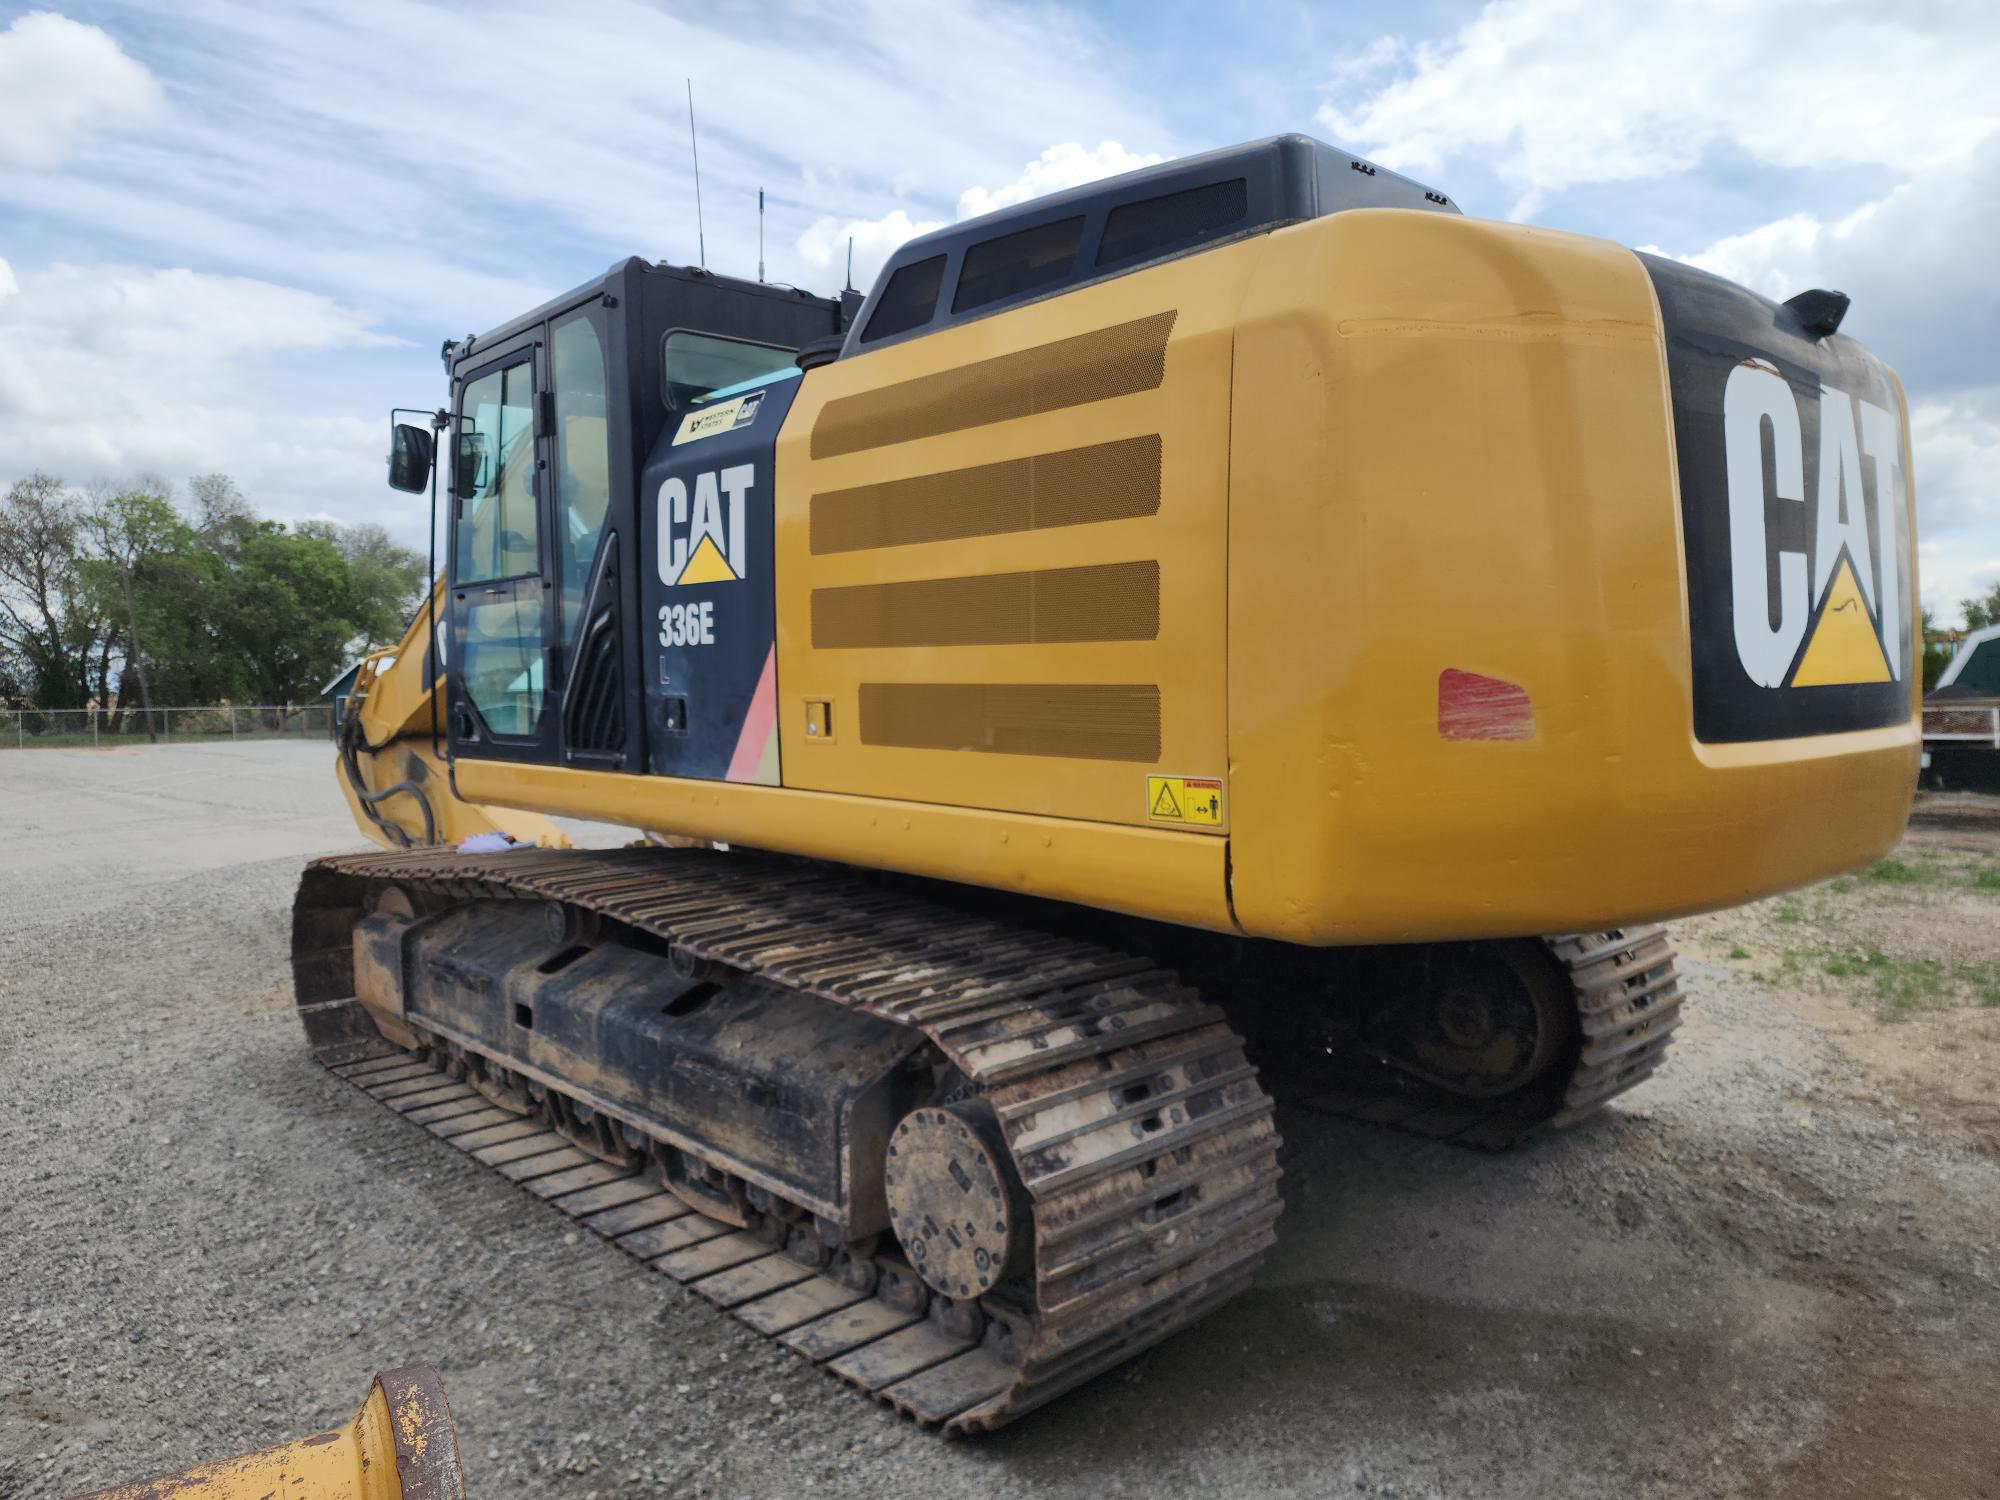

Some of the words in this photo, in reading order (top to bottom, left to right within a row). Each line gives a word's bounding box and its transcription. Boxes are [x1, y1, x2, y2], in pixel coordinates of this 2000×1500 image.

[657, 463, 755, 587] CAT
[1724, 357, 1901, 689] CAT
[659, 601, 715, 648] 336E
